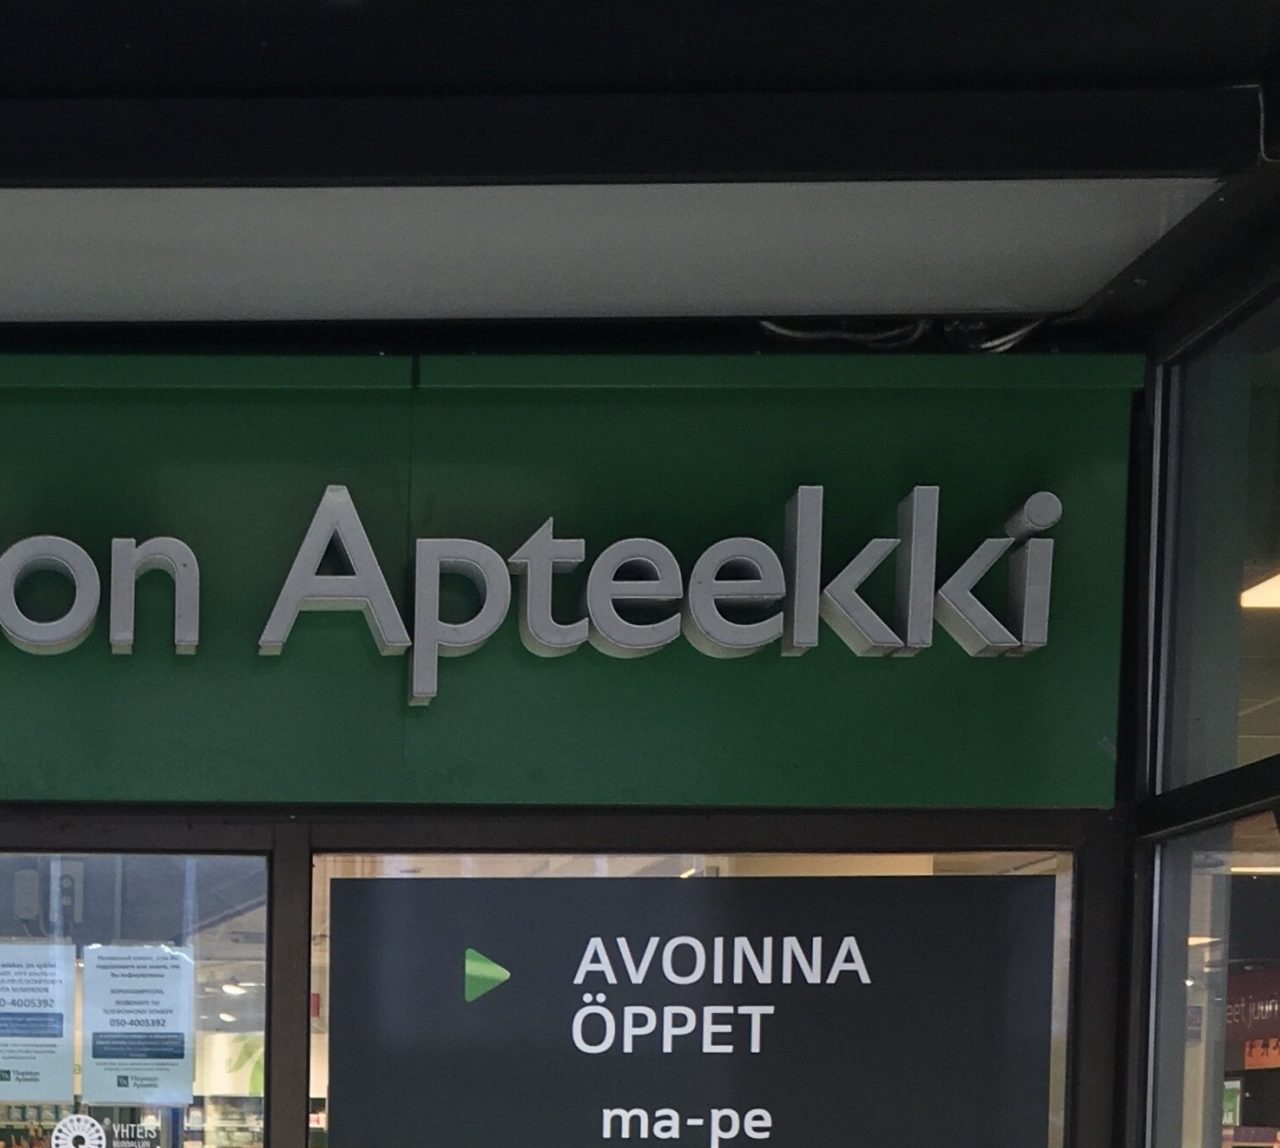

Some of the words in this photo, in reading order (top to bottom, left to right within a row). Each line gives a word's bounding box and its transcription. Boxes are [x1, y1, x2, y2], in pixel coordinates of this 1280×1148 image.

[257, 484, 1063, 706] Apteekki
[573, 935, 872, 986] AVOINNA
[571, 992, 775, 1054] ÖPPET
[112, 1123, 157, 1139] YHTEIS
